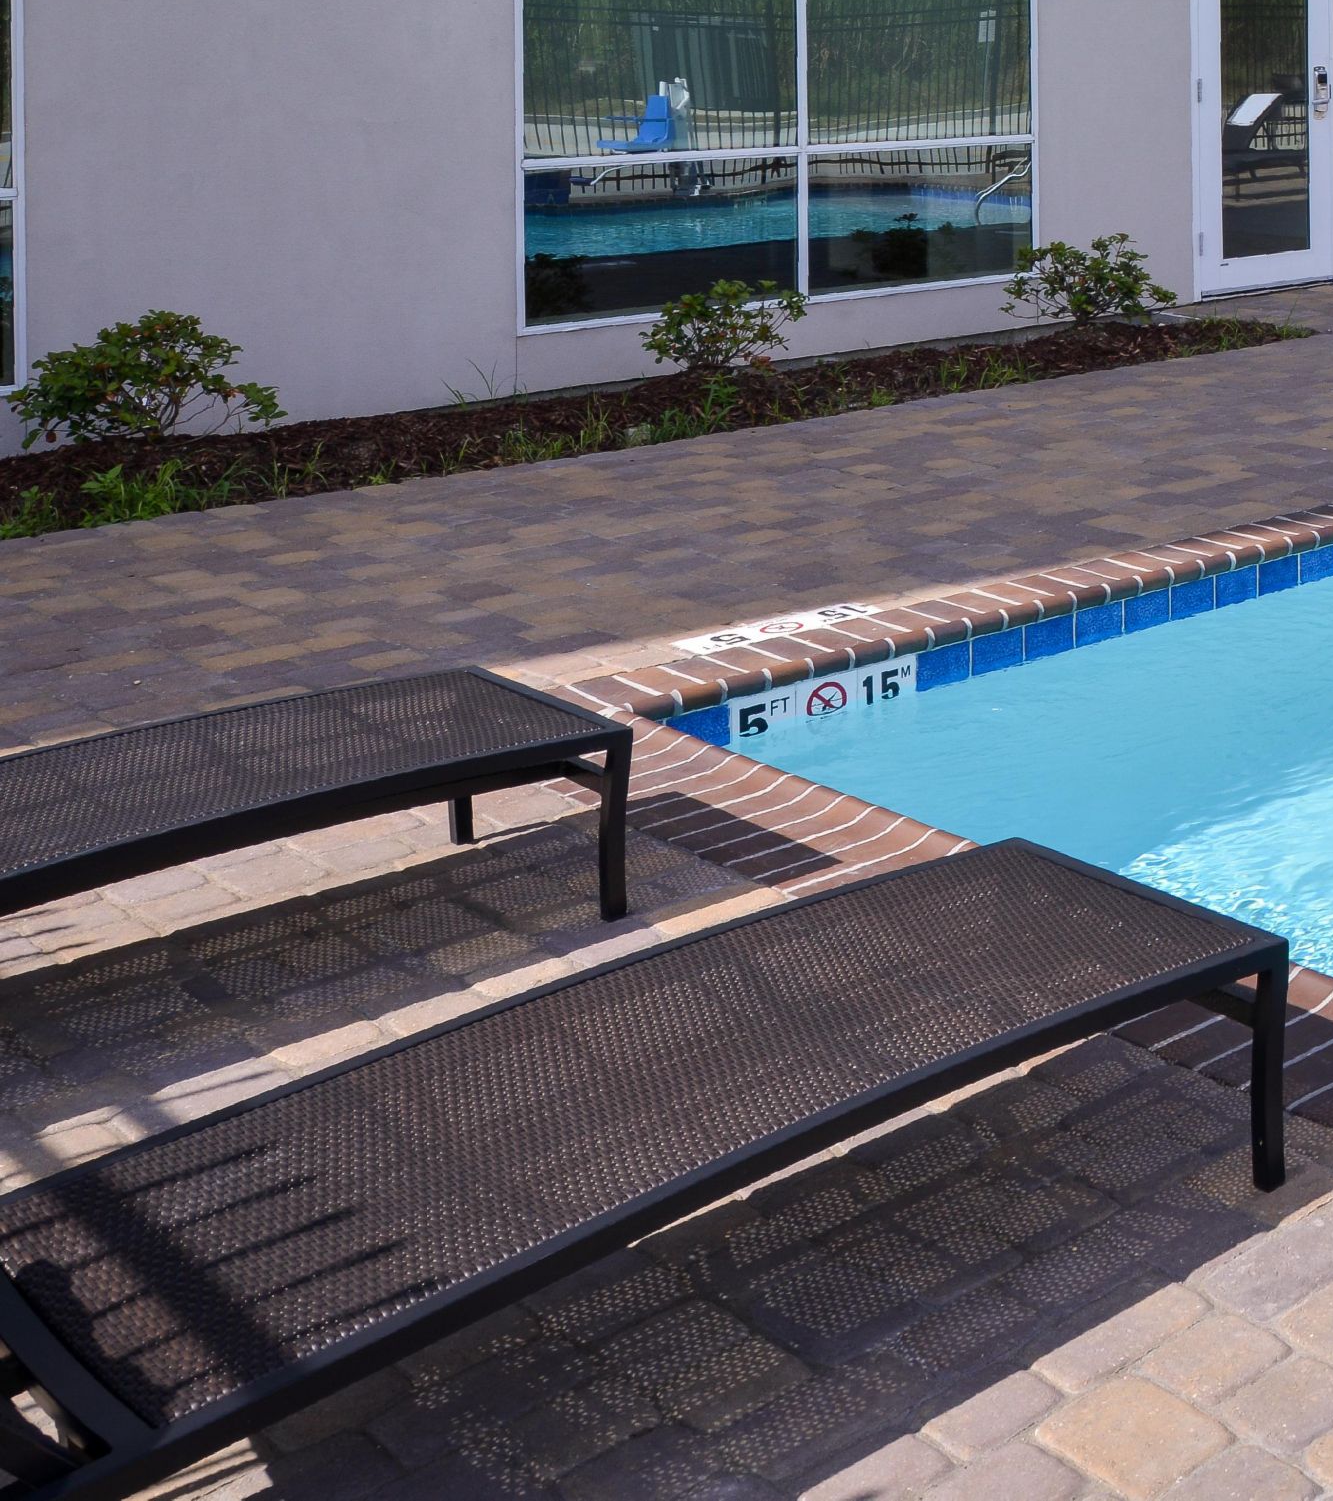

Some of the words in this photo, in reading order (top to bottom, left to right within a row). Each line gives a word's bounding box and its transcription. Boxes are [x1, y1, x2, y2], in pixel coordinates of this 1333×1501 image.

[900, 665, 911, 678] M
[739, 703, 769, 737] 5
[770, 696, 790, 716] FT
